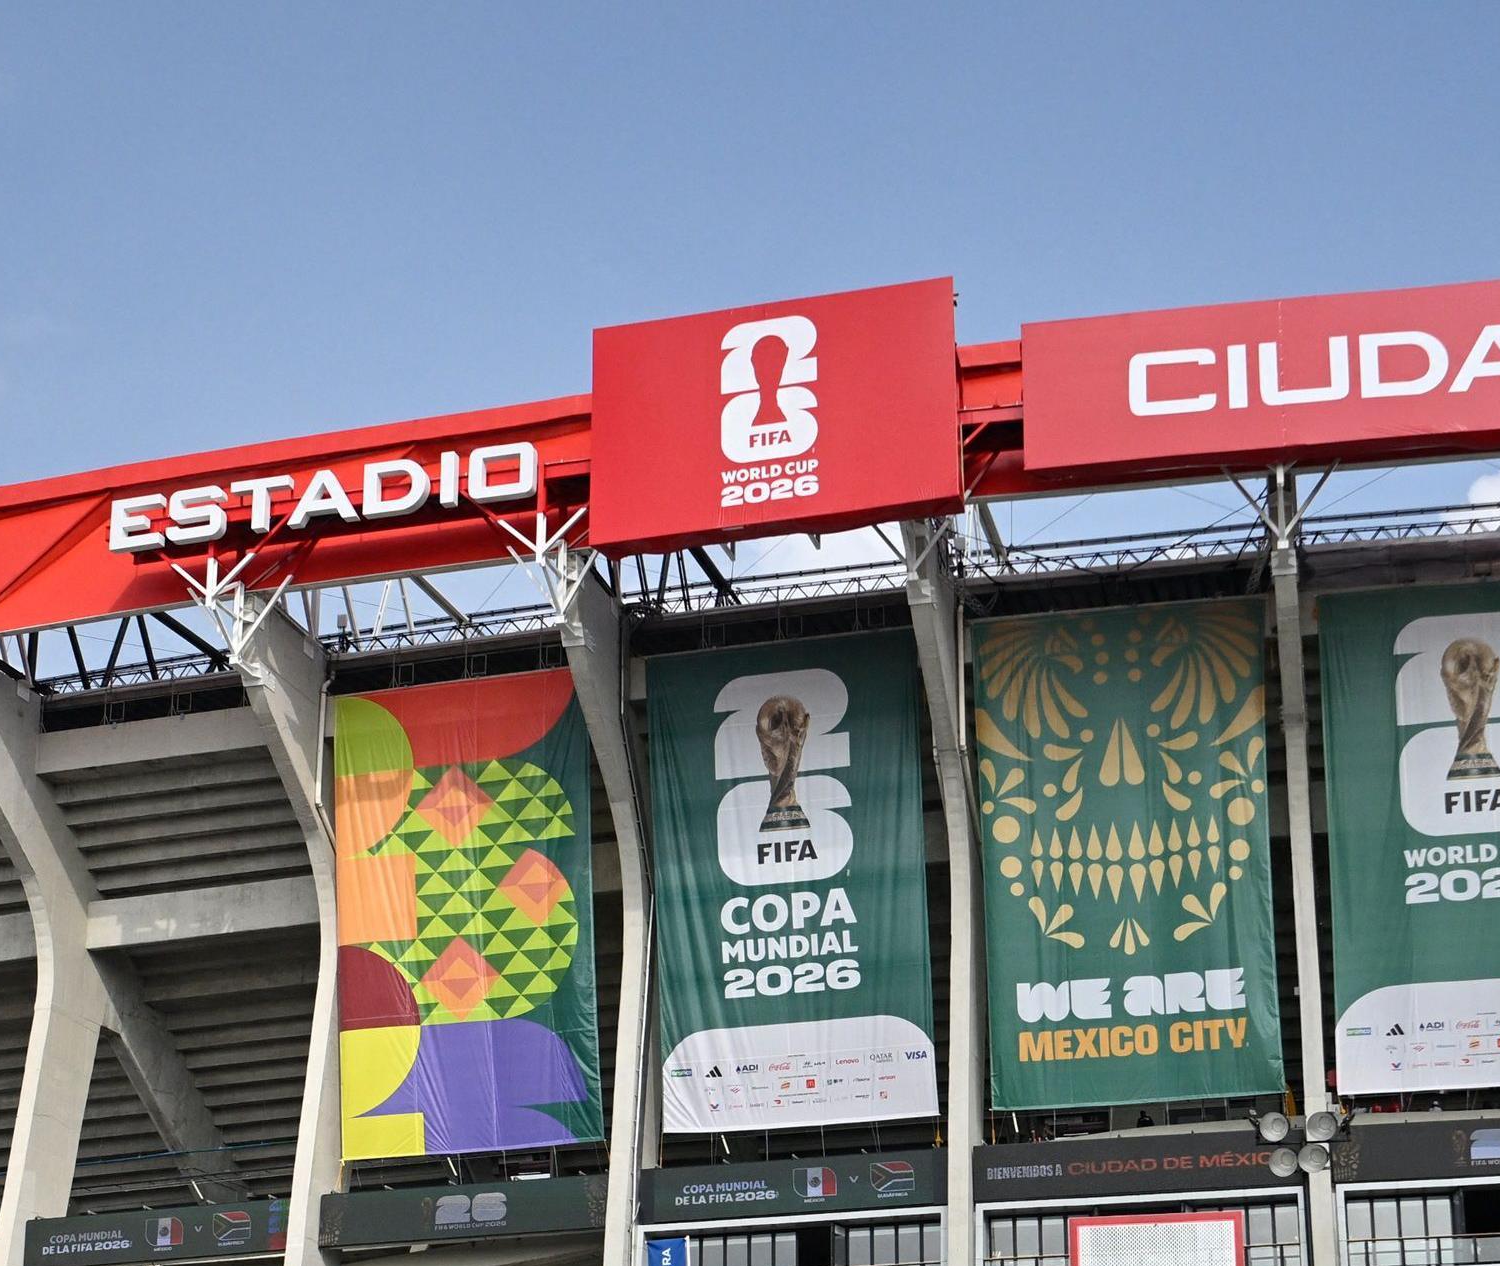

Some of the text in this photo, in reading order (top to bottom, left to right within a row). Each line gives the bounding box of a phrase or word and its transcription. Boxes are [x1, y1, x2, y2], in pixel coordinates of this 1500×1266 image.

[748, 428, 791, 449] FIFA
[720, 459, 818, 483] WORLD CUP
[108, 441, 539, 555] ESTADIO
[721, 475, 818, 507] 2026
[757, 840, 817, 864] FIFA
[1404, 844, 1498, 868] WORLD
[720, 888, 857, 935] COPA
[721, 929, 858, 964] MUNDIAL
[723, 959, 861, 999] 2026
[1016, 978, 1112, 1022] WE
[1019, 1018, 1247, 1062] MEXICO CITY
[905, 1051, 927, 1060] VISA
[987, 1156, 1193, 1180] BIENVENIDOS CIUDAD DE
[675, 1190, 776, 1206] DE LA FIFA 2026
[683, 1180, 767, 1194] COPA MUNDIAL
[42, 1240, 129, 1255] DE LA FIFA 2026
[50, 1230, 123, 1243] COPA MUNDIAL
